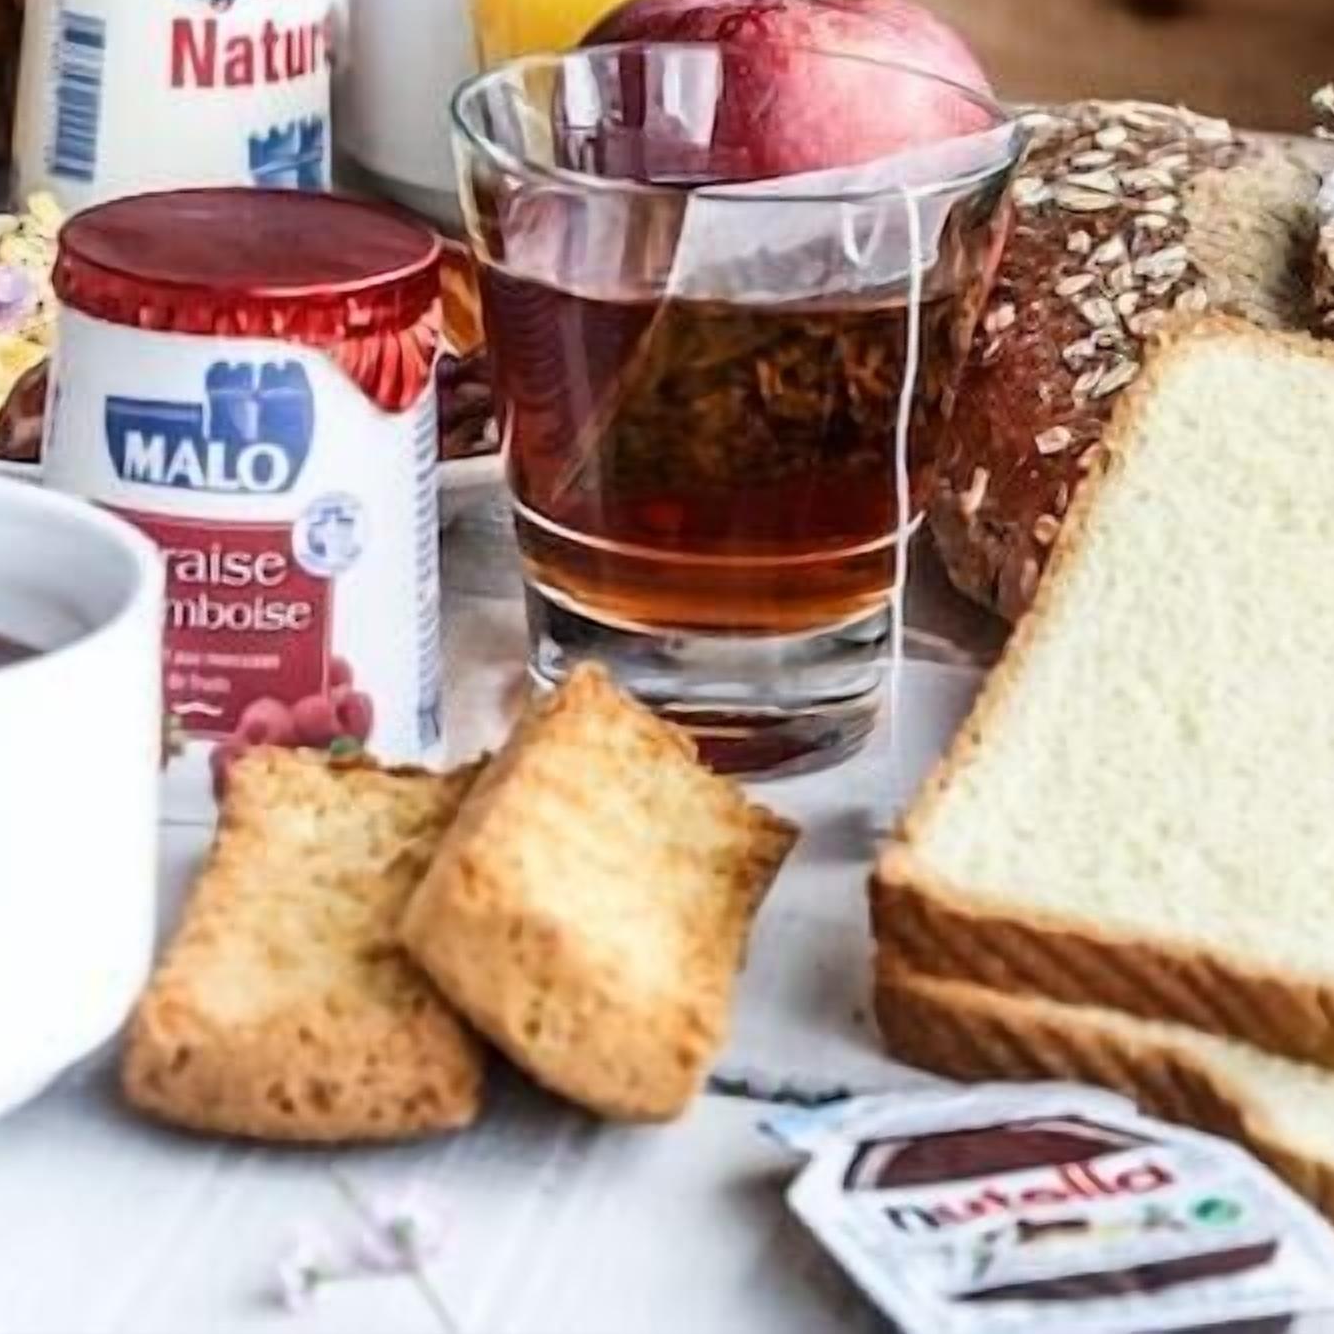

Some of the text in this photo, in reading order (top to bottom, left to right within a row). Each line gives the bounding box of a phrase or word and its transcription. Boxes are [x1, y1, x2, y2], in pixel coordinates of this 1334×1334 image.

[123, 429, 290, 492] MALO
[162, 542, 288, 587] raise
[168, 592, 313, 632] mboise
